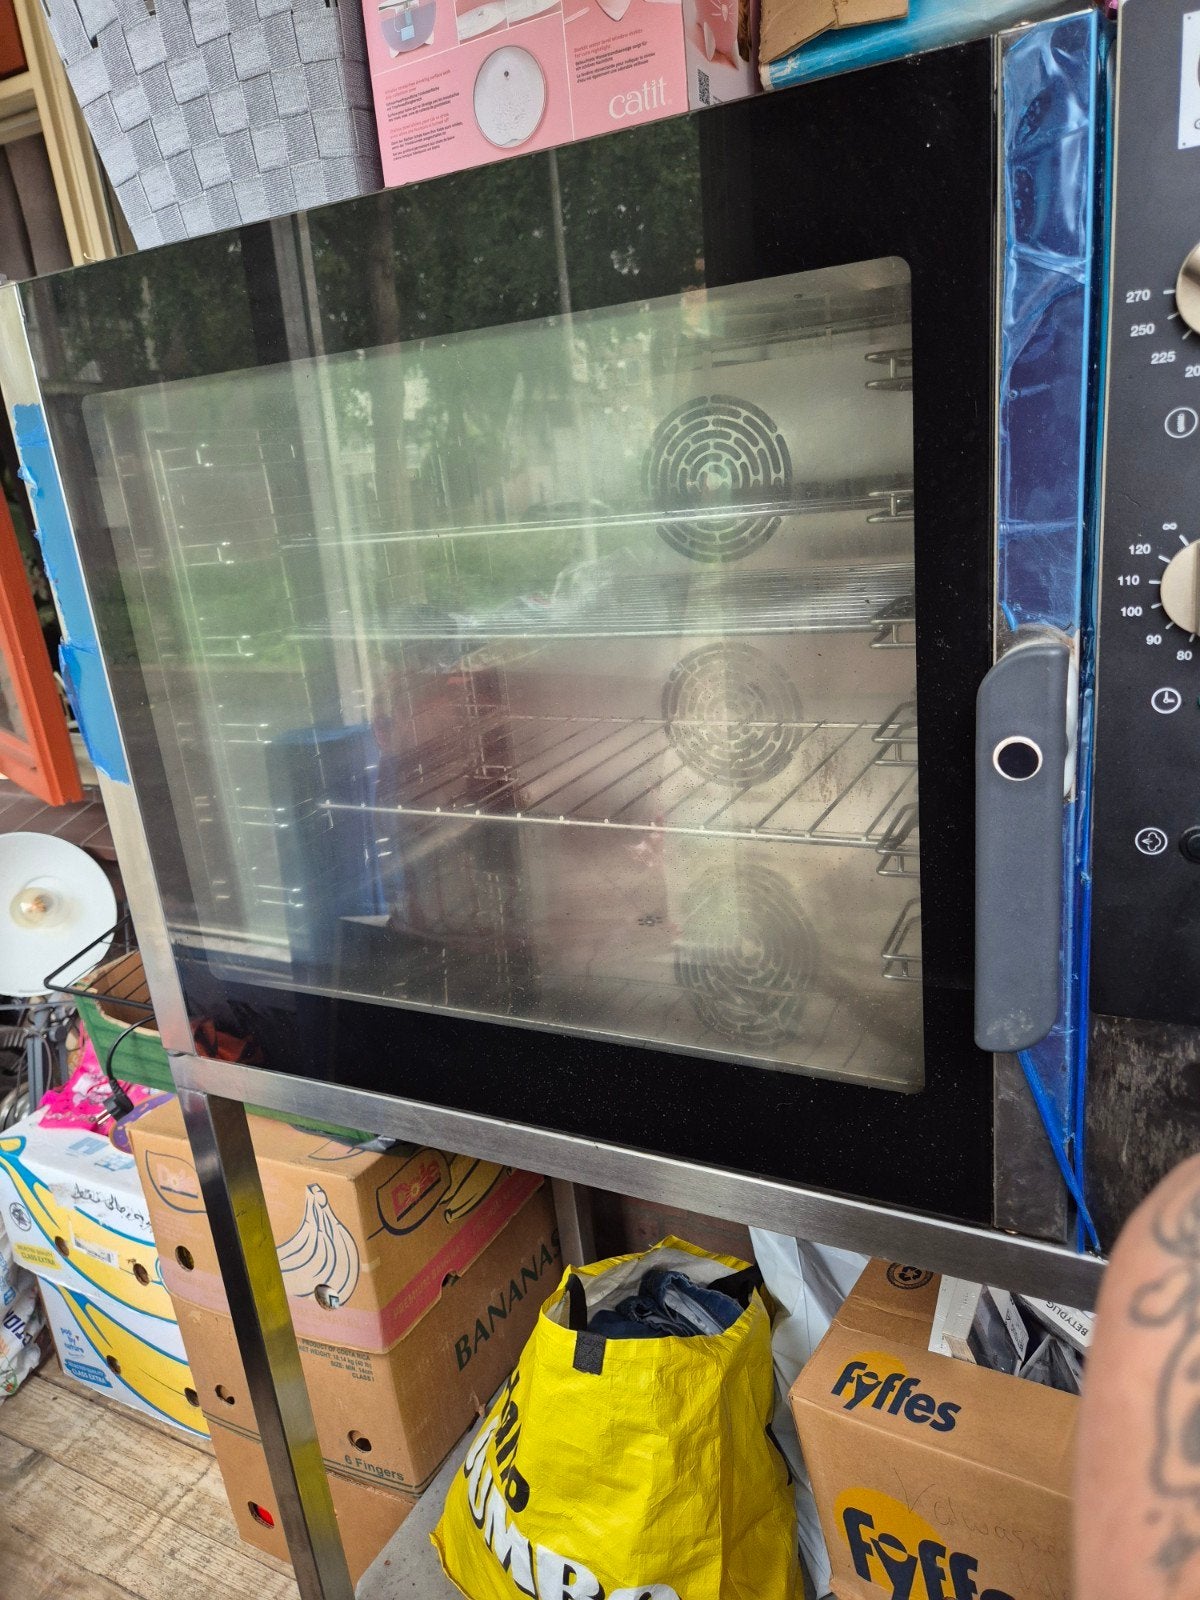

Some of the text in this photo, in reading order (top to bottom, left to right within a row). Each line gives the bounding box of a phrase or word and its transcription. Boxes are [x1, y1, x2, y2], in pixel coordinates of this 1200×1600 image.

[608, 77, 668, 120] catit
[1126, 289, 1151, 303] 270
[1130, 323, 1155, 337] 250
[1150, 350, 1176, 364] 225
[1129, 543, 1151, 555] 120
[1117, 575, 1140, 586] 110
[1120, 606, 1143, 617] 100
[1146, 634, 1162, 646] 90
[1176, 650, 1193, 661] 80
[831, 1361, 962, 1433] fyffes
[344, 1454, 405, 1482] 6 Fingers
